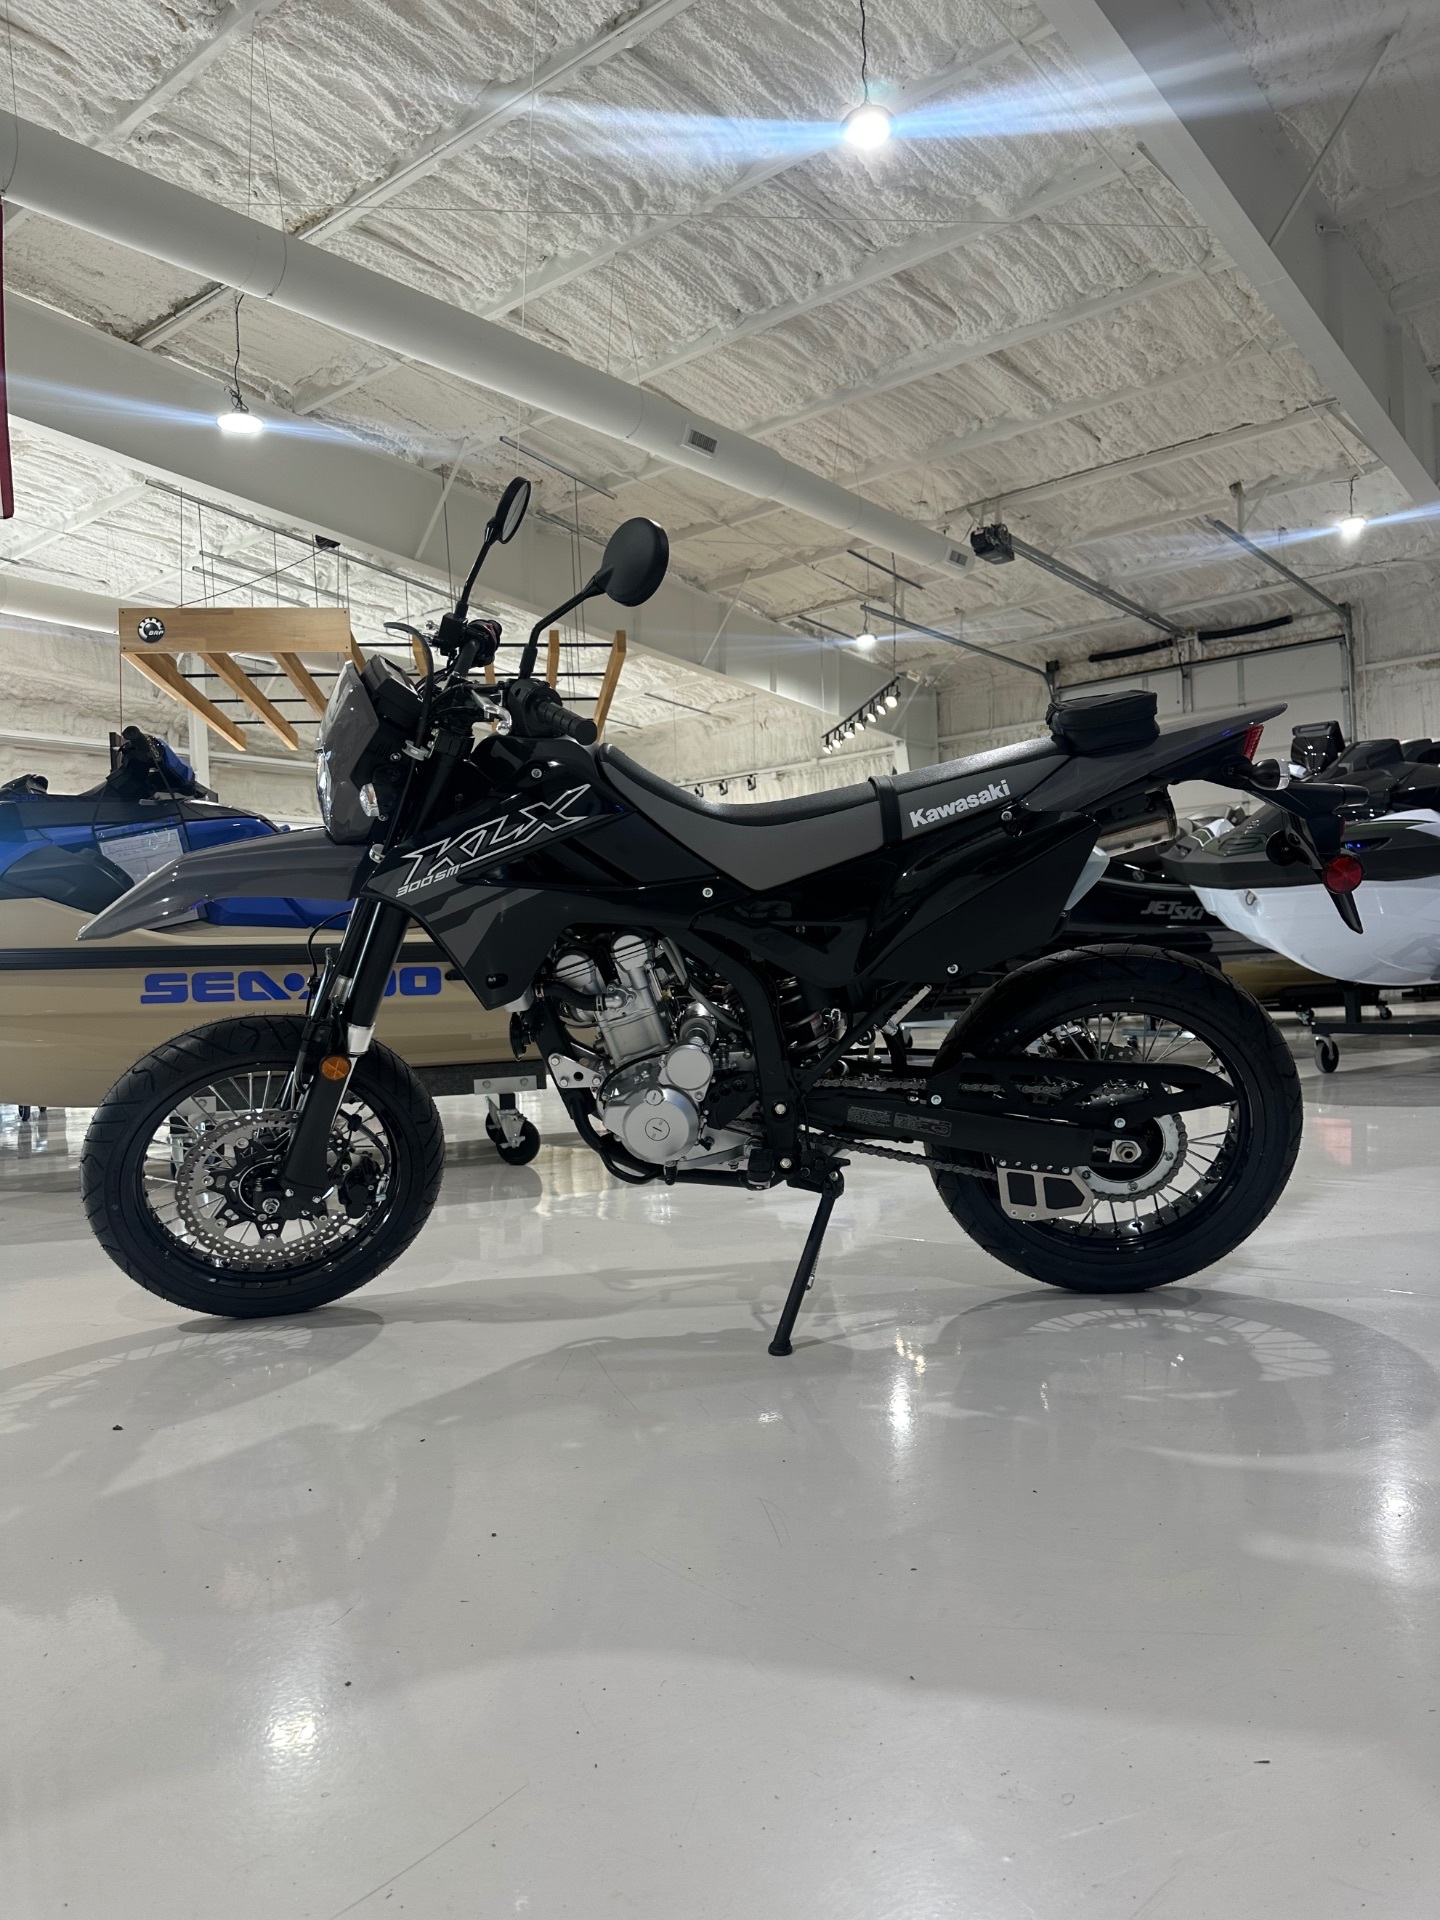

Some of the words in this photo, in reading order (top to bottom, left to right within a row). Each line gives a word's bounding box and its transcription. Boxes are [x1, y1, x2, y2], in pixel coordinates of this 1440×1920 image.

[909, 779, 1011, 828] Kawasaki
[401, 783, 591, 886] KLX
[1140, 900, 1182, 915] JET
